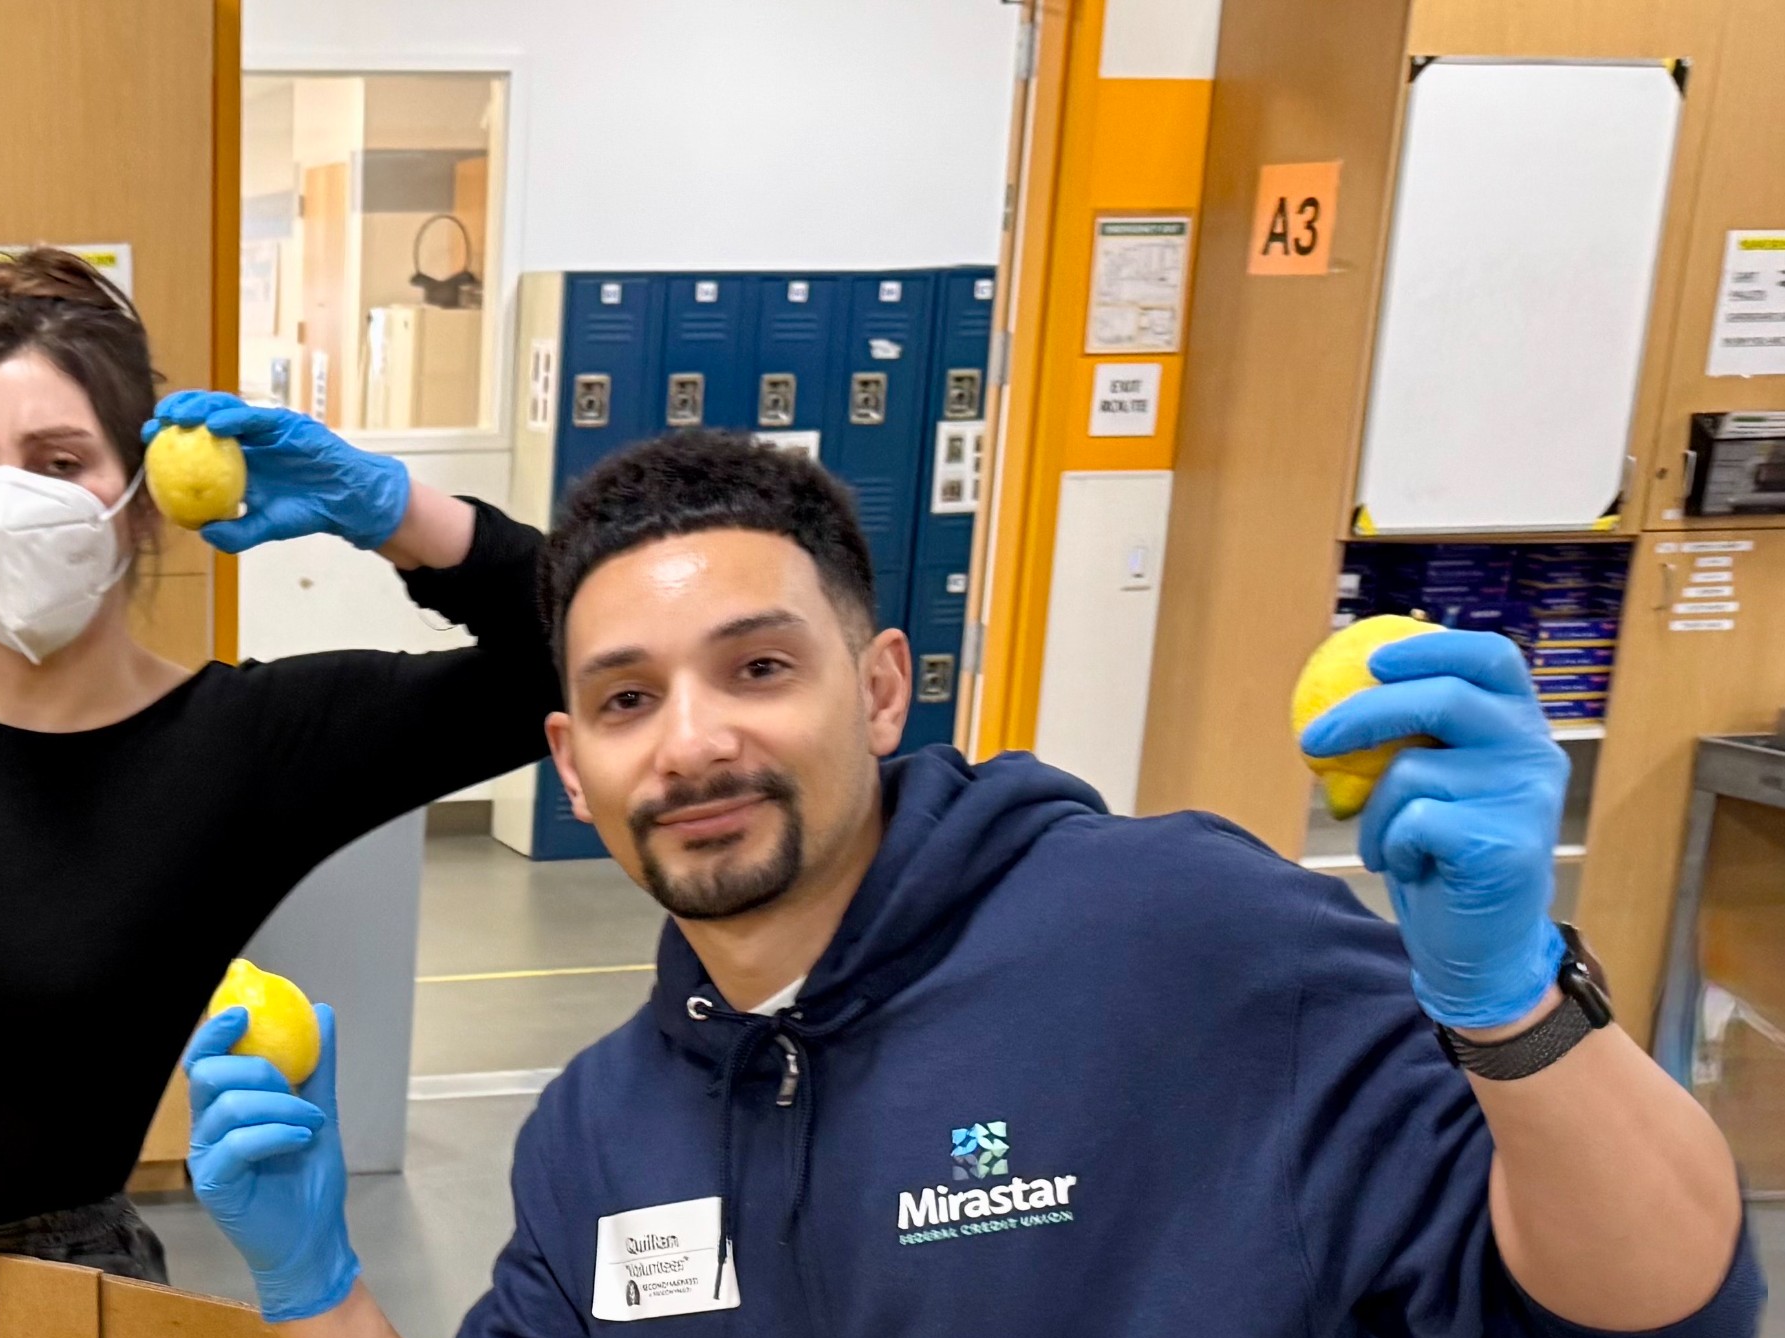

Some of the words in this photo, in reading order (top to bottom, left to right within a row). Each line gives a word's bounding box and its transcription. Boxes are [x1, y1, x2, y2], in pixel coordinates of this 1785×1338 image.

[1261, 196, 1321, 257] A3
[897, 1174, 1077, 1230] Mirastar
[959, 1217, 1019, 1237] CREDIT
[1019, 1210, 1075, 1228] UNION
